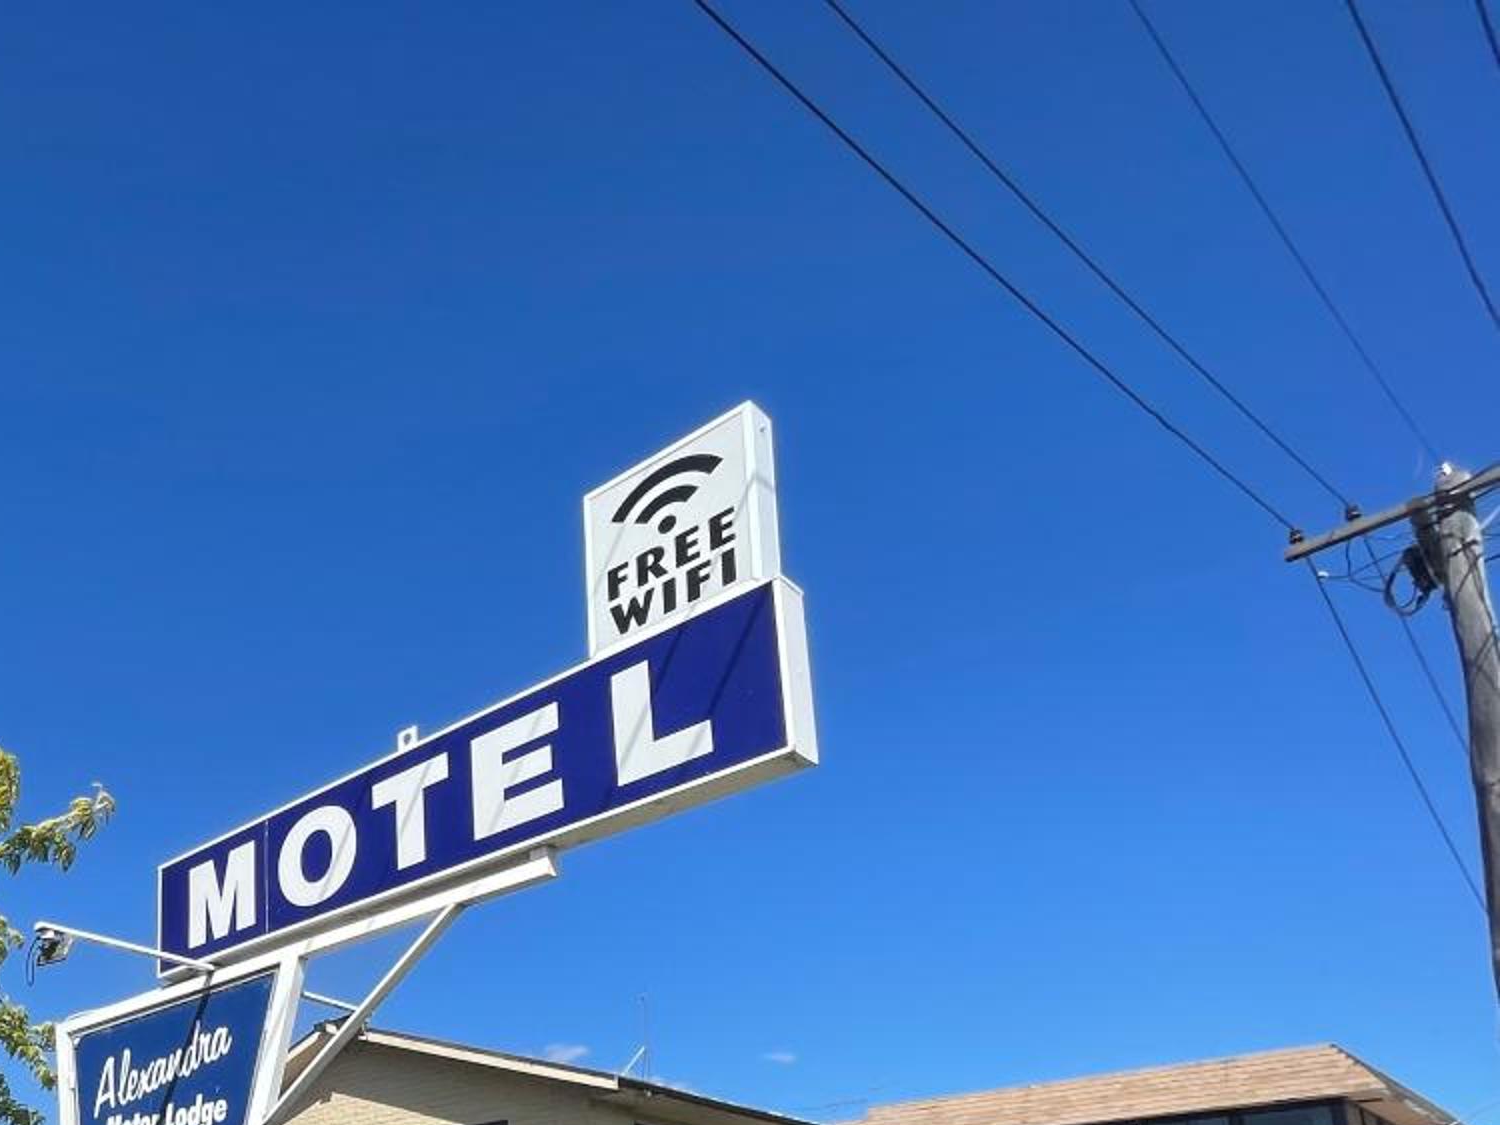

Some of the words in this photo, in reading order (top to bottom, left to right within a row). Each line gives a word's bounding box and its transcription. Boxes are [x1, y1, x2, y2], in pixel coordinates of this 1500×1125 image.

[607, 507, 737, 602] FREE
[608, 550, 737, 635] WIFI
[187, 660, 714, 949] MOTEL
[93, 1020, 232, 1118] Alexandra
